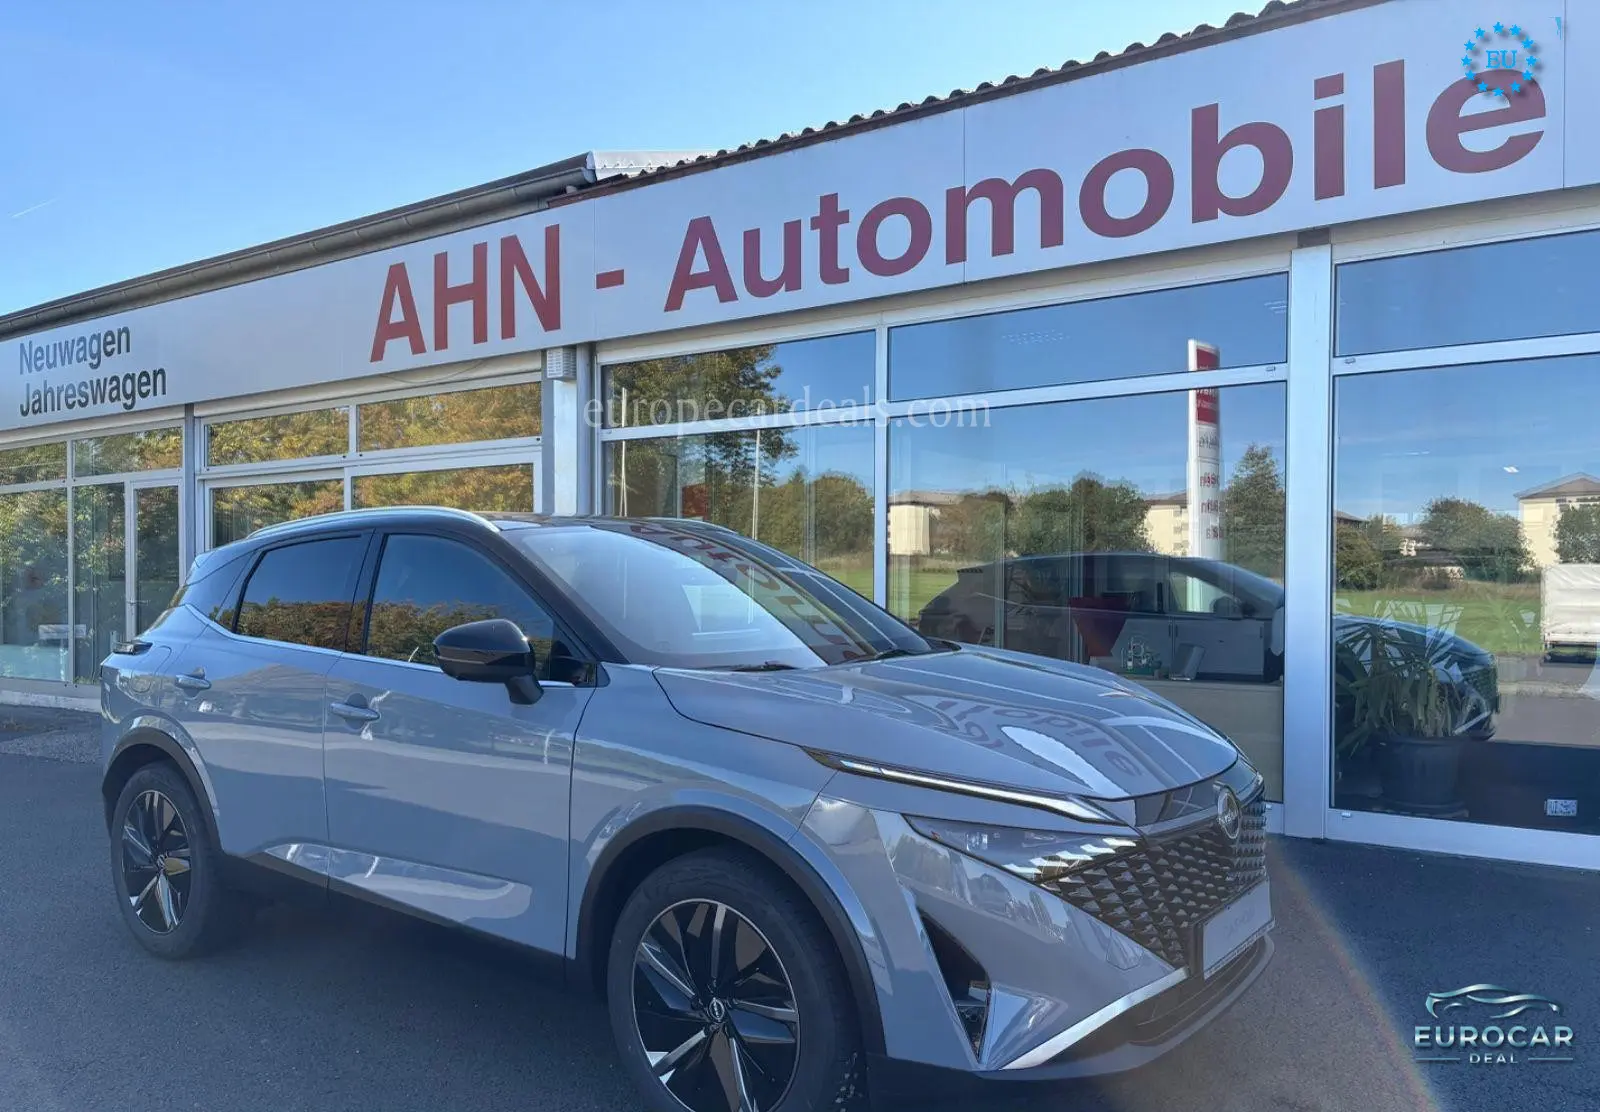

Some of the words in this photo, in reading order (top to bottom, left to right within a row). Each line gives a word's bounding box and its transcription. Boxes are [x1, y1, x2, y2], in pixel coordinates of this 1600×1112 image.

[370, 223, 561, 362] AHN
[664, 58, 1547, 313] Automobile
[19, 326, 131, 375] Neuwagen
[19, 367, 167, 417] Jahreswagen
